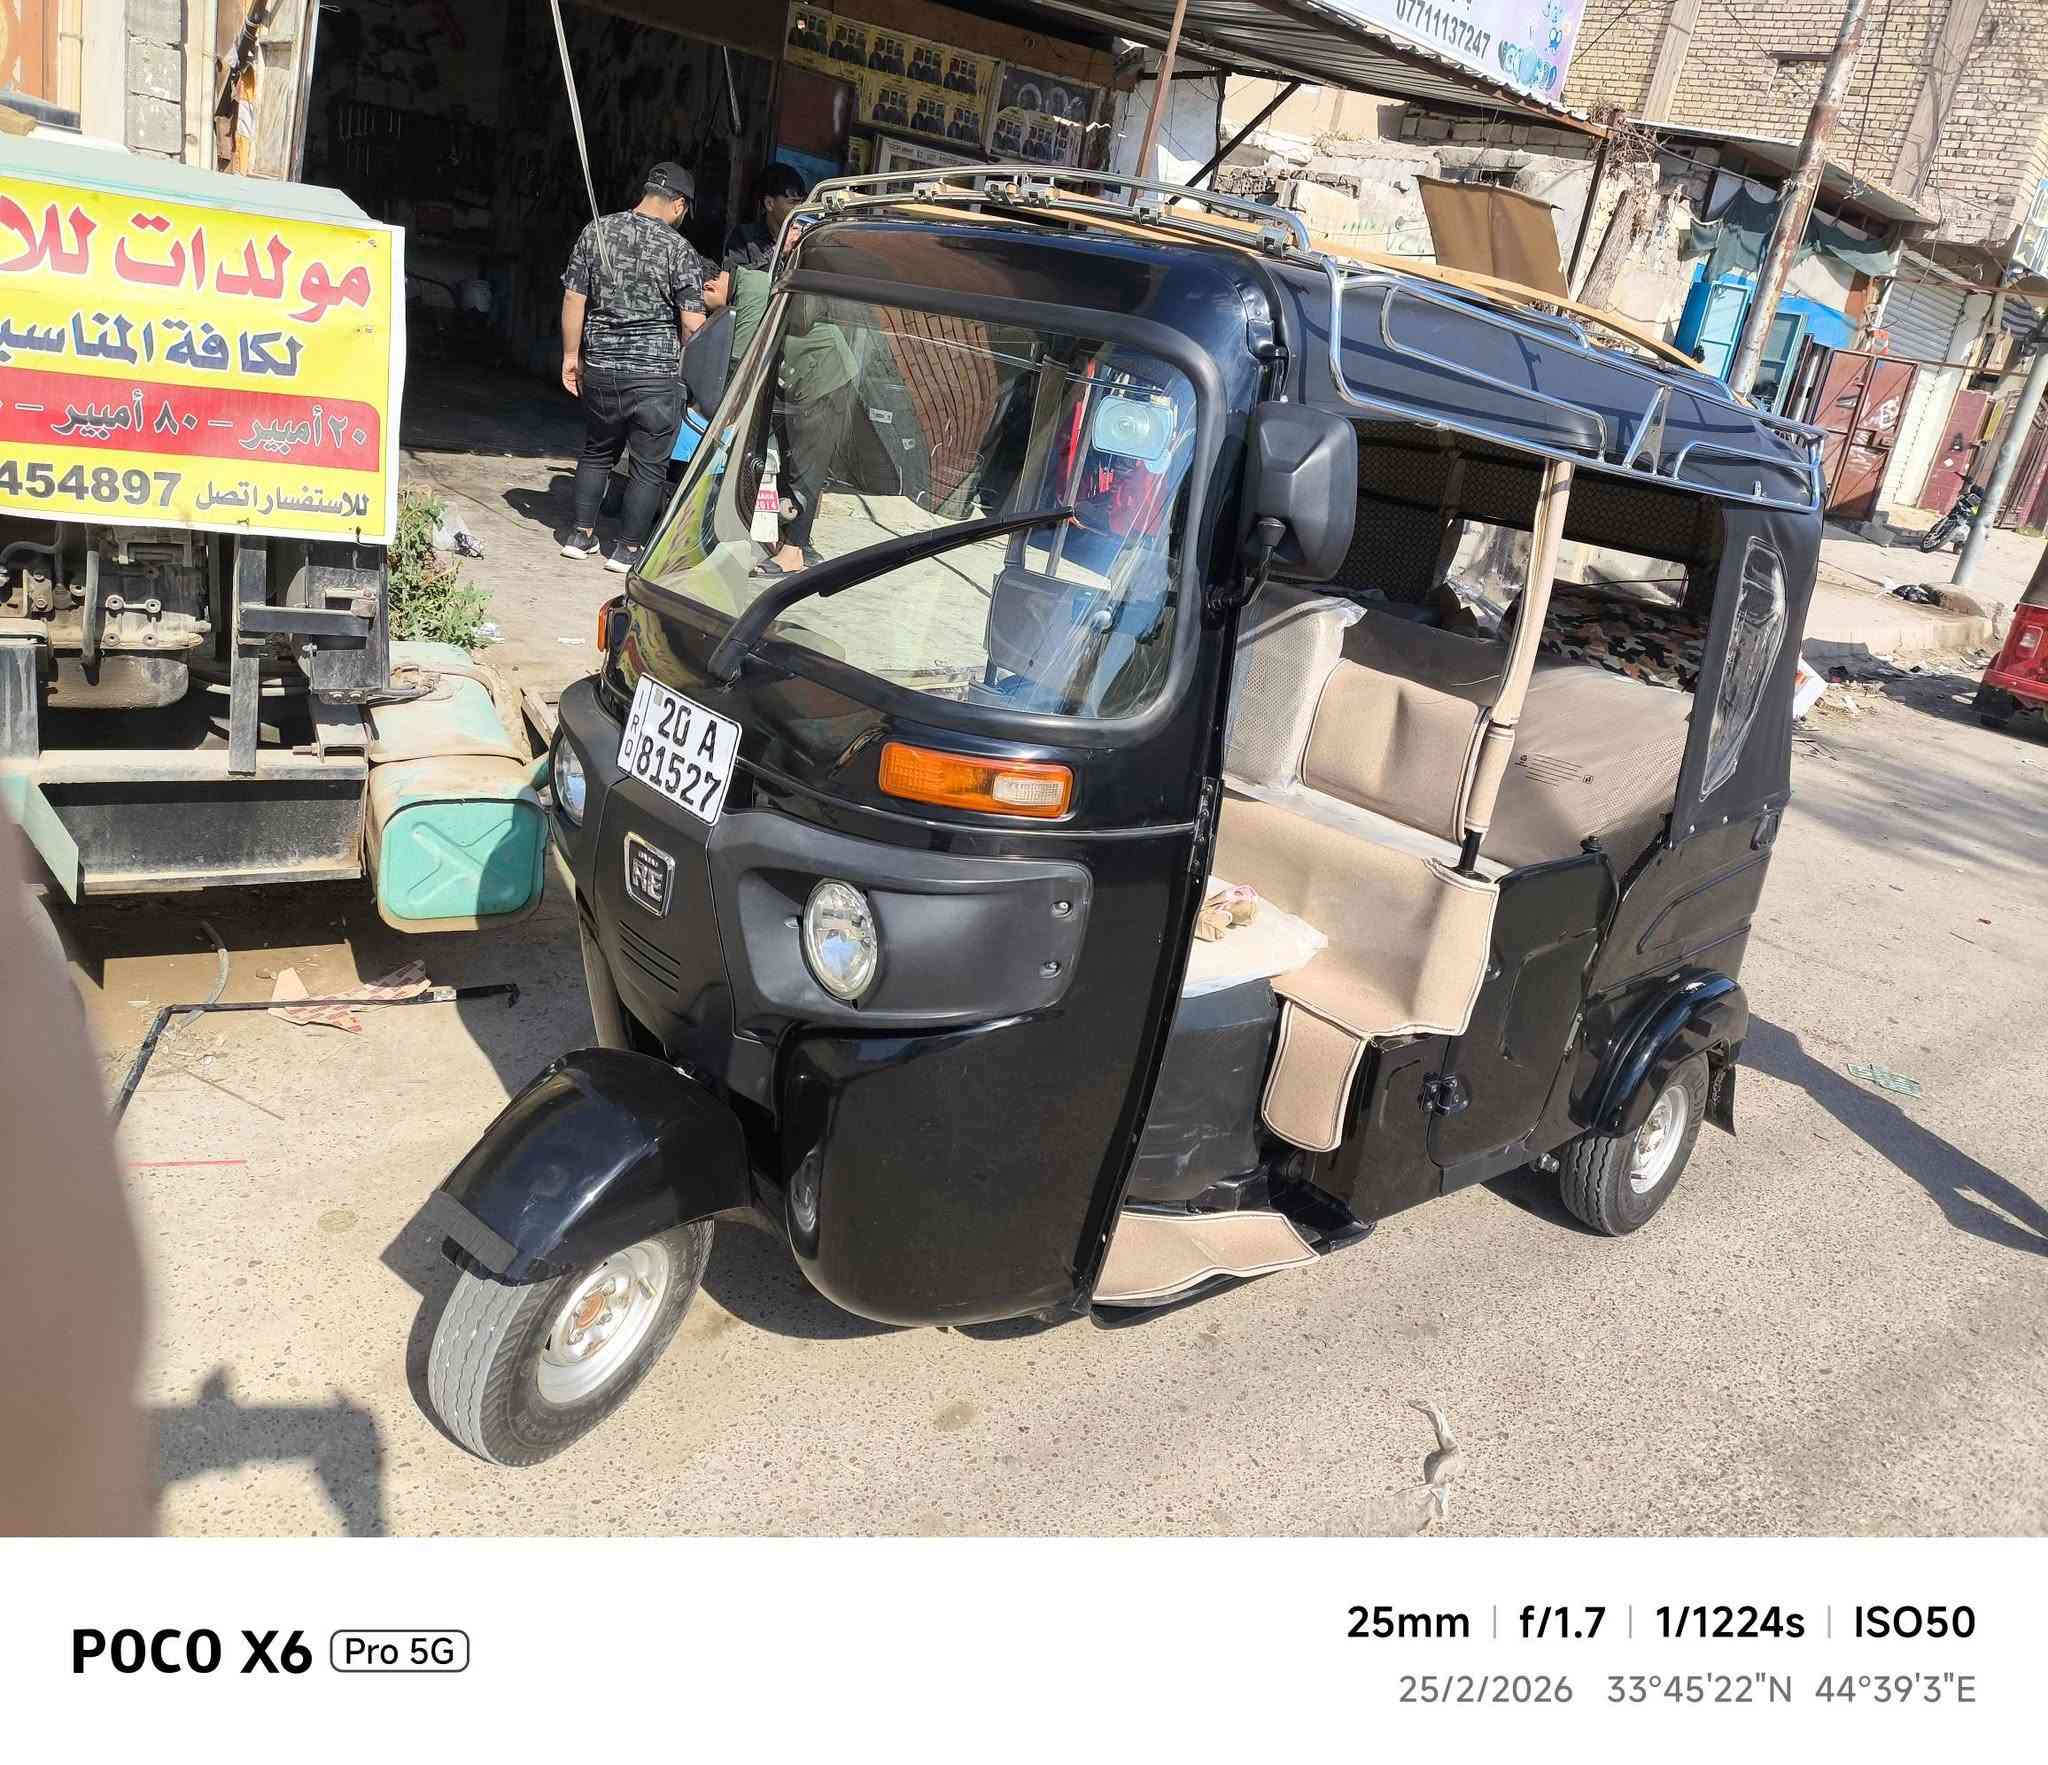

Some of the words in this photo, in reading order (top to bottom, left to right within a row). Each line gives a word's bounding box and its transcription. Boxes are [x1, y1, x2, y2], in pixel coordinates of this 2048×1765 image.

[1395, 0, 1491, 60] 07711137247
[114, 211, 372, 323] مولدات
[162, 318, 304, 378] لكافة
[657, 696, 692, 748] 20
[696, 719, 718, 763] A
[636, 735, 723, 813] 81527
